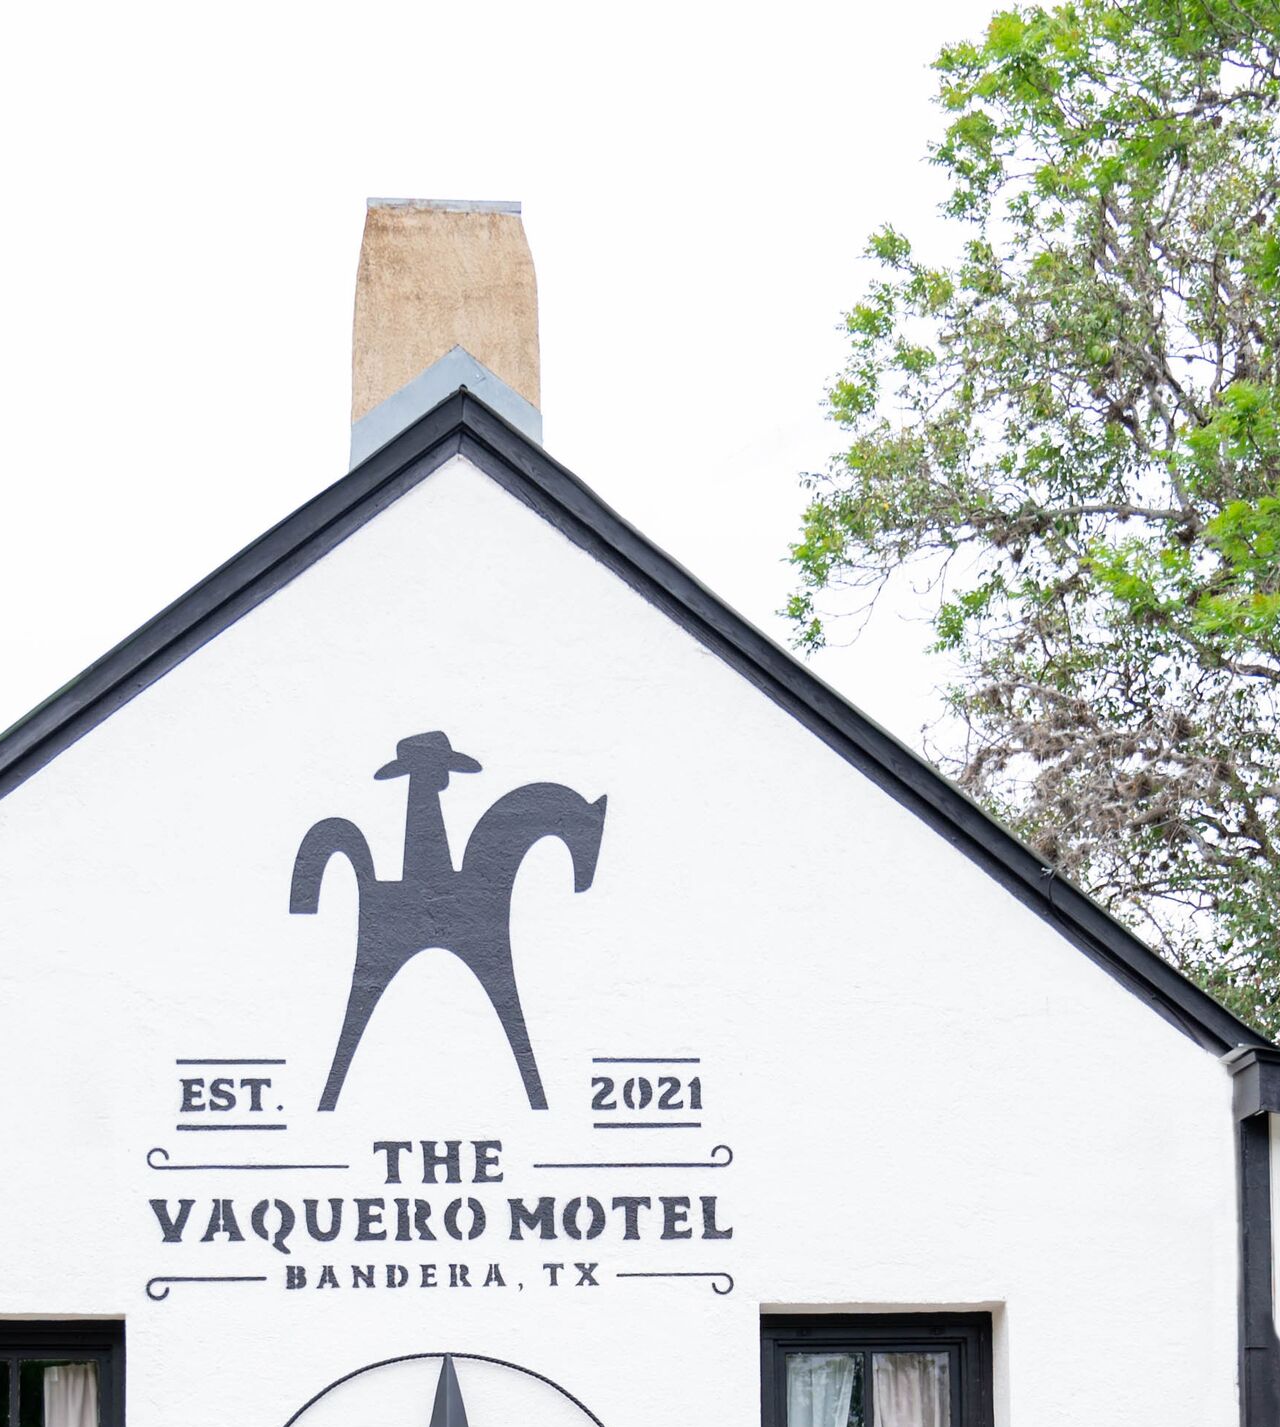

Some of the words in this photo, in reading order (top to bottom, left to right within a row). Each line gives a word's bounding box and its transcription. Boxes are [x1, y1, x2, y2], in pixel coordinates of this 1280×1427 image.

[179, 1078, 284, 1113] EST.
[591, 1076, 703, 1111] 2021
[373, 1140, 504, 1184] THE
[149, 1197, 486, 1255] VAQUERO
[508, 1195, 733, 1241] MOTEL
[285, 1263, 525, 1293] BANDERA,
[542, 1262, 600, 1287] TX
